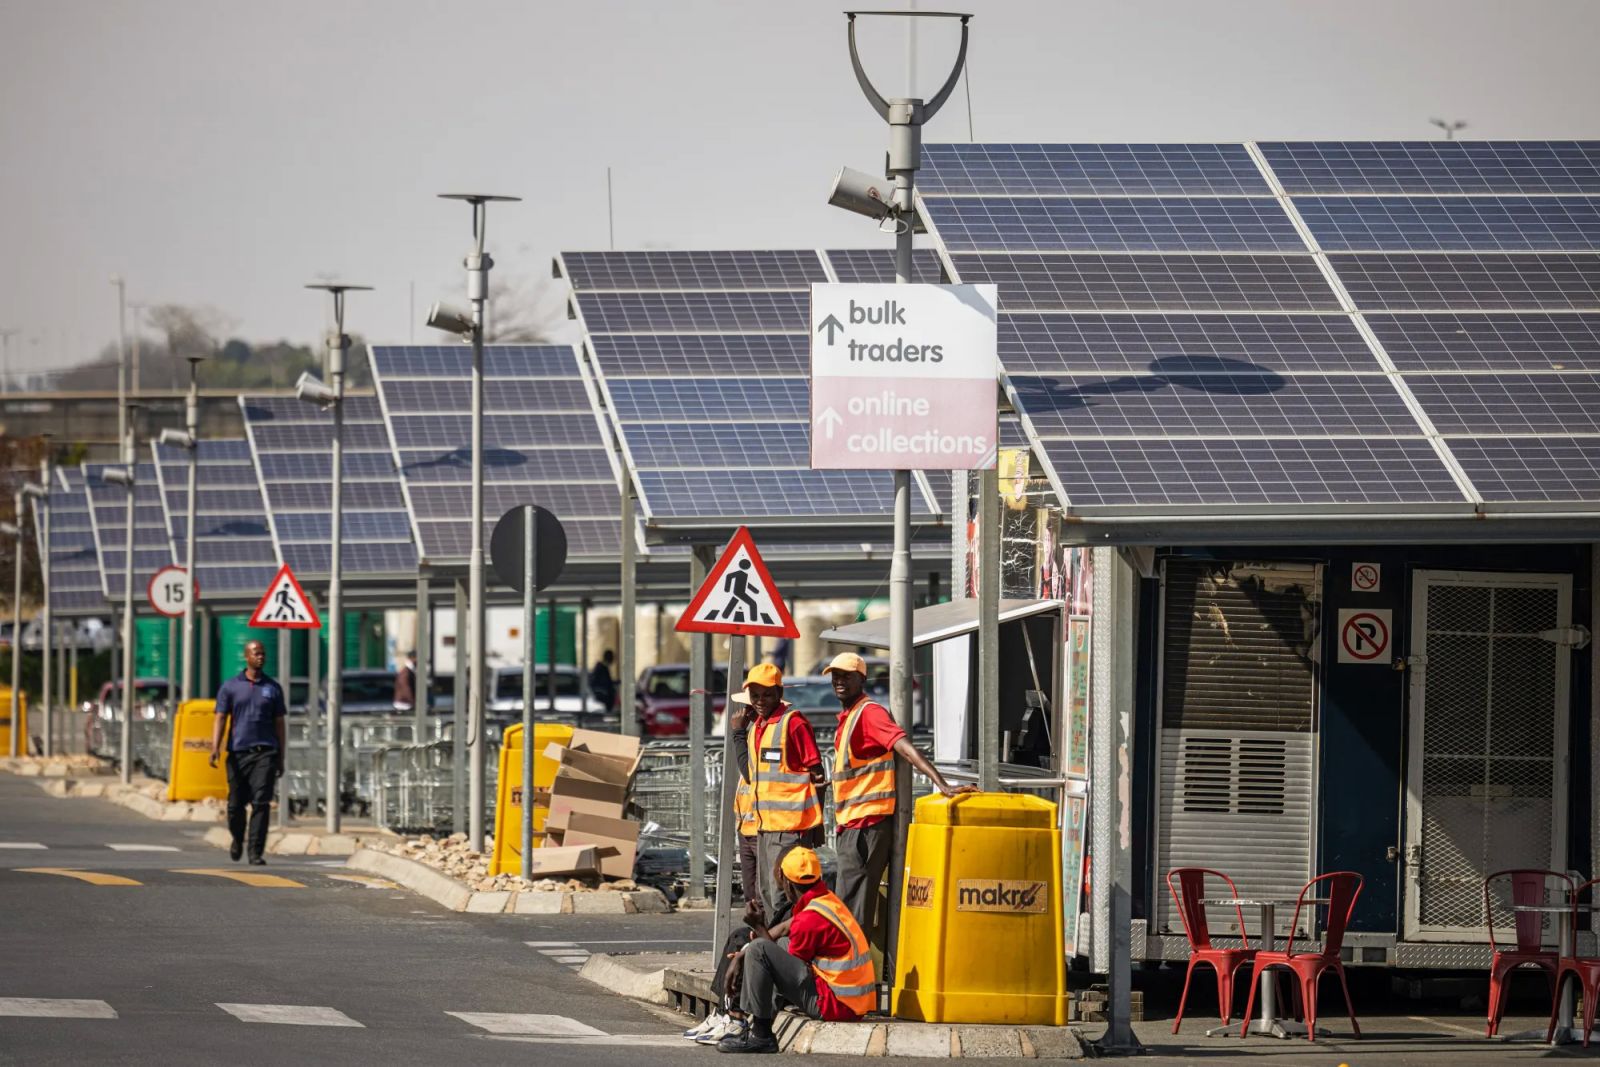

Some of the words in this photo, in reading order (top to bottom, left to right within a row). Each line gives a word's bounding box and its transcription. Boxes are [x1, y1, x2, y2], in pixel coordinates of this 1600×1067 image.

[849, 299, 906, 325] bulk
[848, 337, 943, 363] traders
[847, 390, 930, 416] online
[846, 427, 987, 454] collections
[164, 583, 185, 603] 15
[959, 882, 1041, 907] makro
